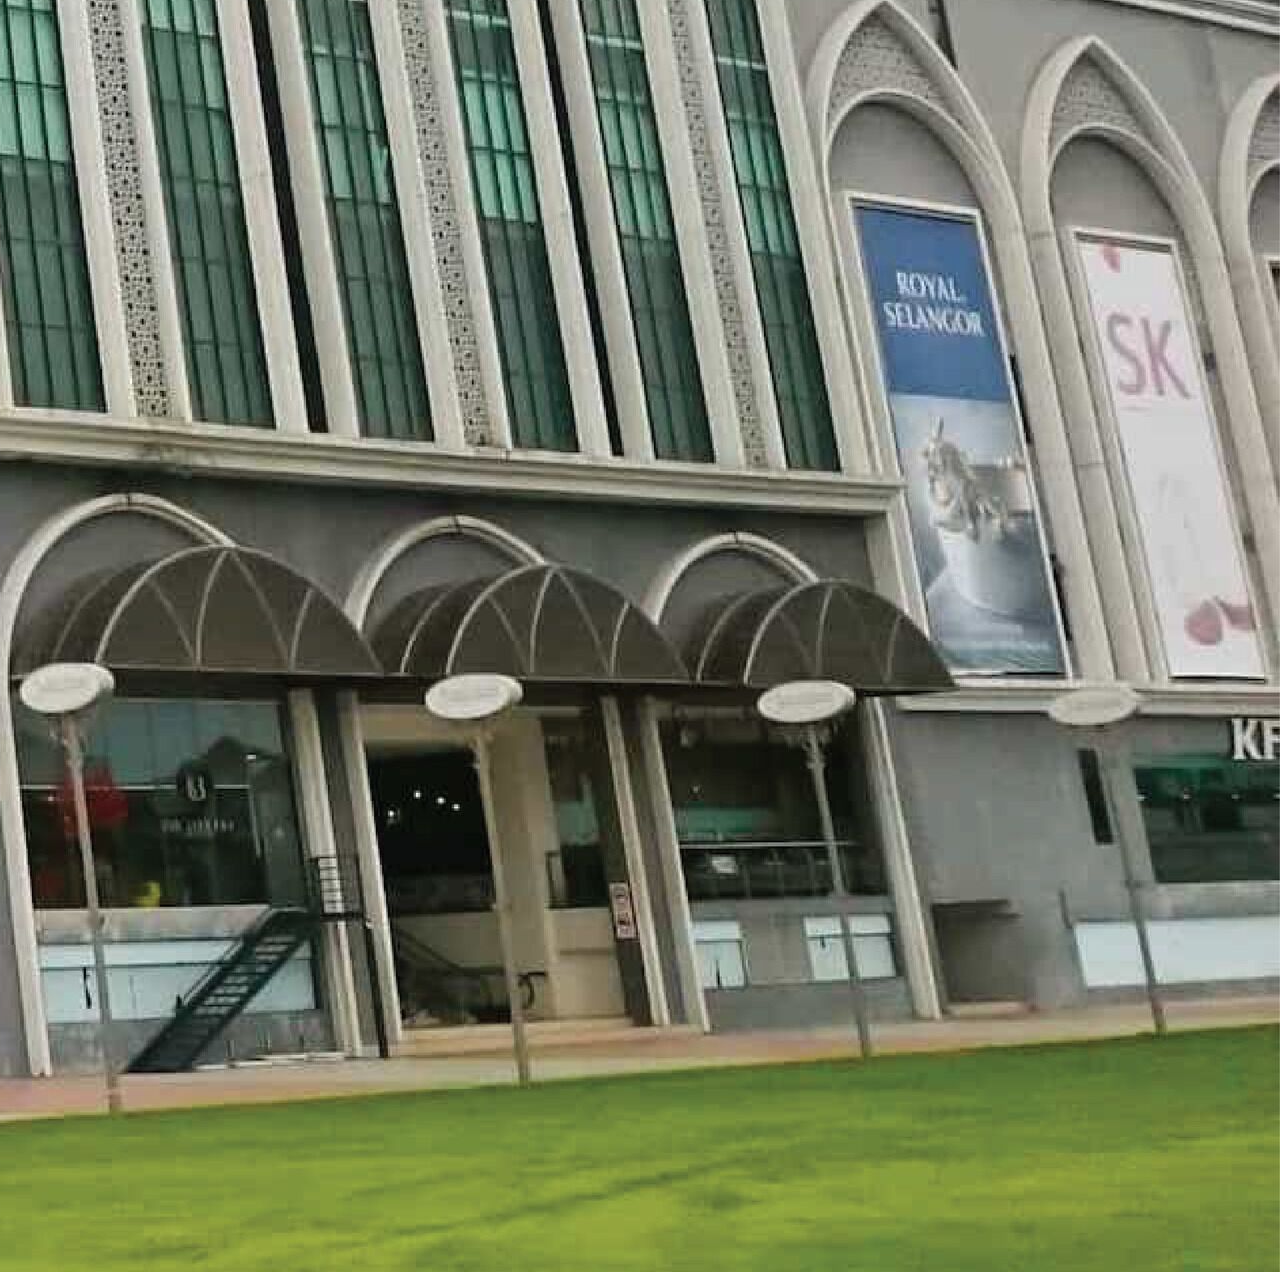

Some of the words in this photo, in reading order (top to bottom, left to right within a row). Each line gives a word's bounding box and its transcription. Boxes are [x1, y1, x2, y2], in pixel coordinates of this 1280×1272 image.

[896, 271, 966, 303] ROYAL
[882, 302, 985, 338] SELANGOR
[1105, 312, 1191, 400] SK
